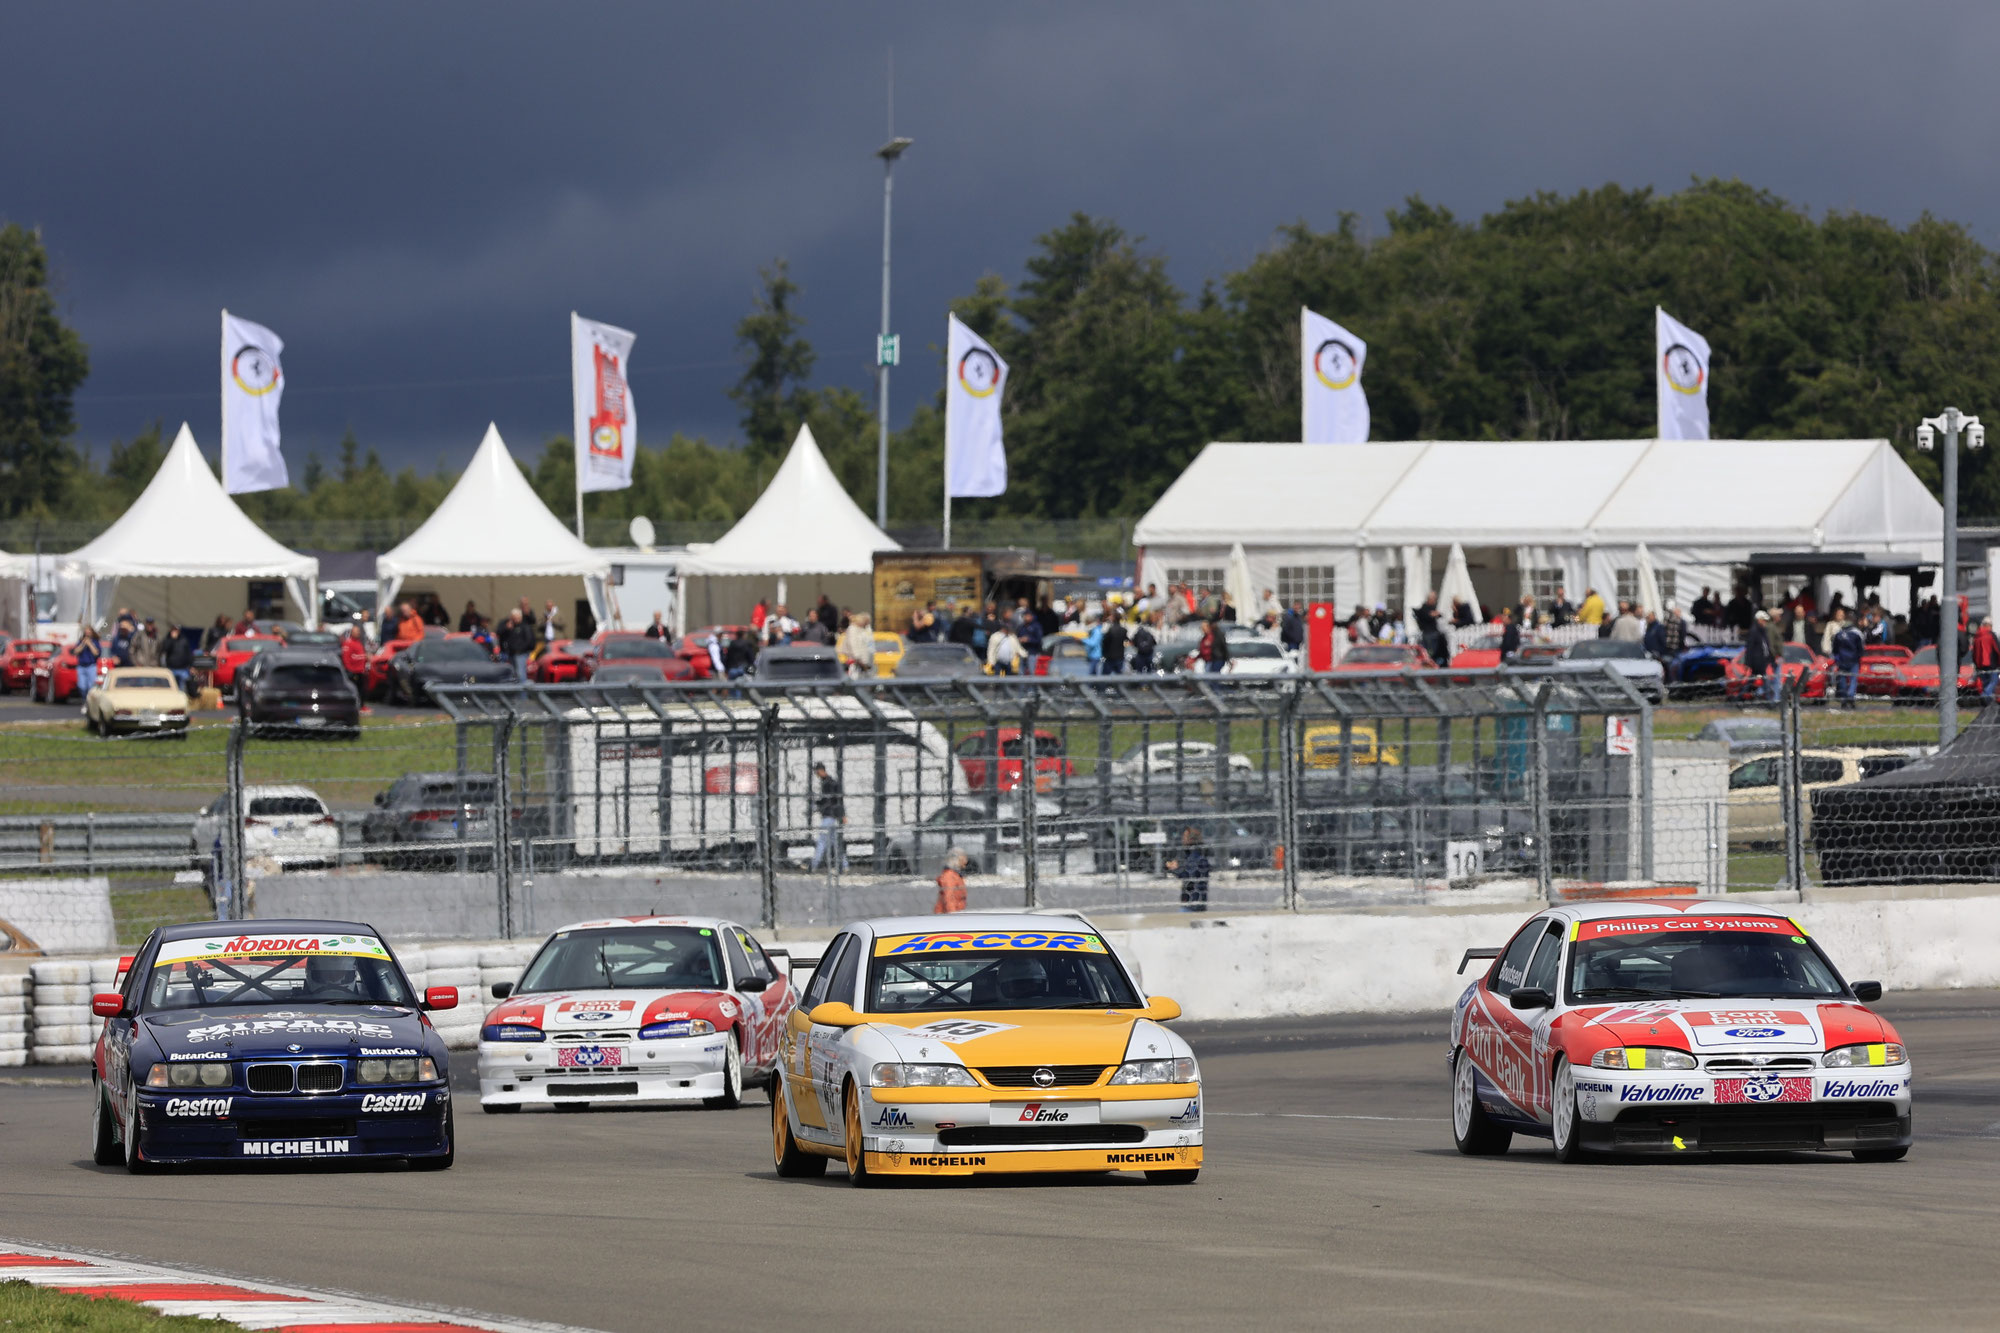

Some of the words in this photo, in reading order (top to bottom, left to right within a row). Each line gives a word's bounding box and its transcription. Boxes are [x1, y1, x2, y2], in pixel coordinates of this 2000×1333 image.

[1453, 851, 1477, 876] 10
[1596, 923, 1660, 933] Philips
[1664, 920, 1699, 930] Car
[1704, 919, 1779, 930] Systems
[223, 936, 320, 953] NORDICA
[888, 933, 1087, 953] ARCOR
[196, 950, 353, 960] www.tourenwagen-golden-era.de
[1498, 960, 1522, 986] Boutsen
[1708, 1010, 1778, 1018] Ford
[1711, 1016, 1785, 1025] Bank
[186, 1020, 392, 1038] MIRAGE
[188, 1028, 274, 1043] GRANITO
[286, 1027, 393, 1039] CERAMICO
[923, 1021, 999, 1036] 45
[1735, 1027, 1775, 1038] Ford
[170, 1051, 228, 1061] ButanGas
[360, 1047, 418, 1056] ButanGas
[1465, 1003, 1493, 1071] Ford
[1495, 1034, 1527, 1106] Bank
[1575, 1082, 1613, 1093] MICHELIN
[1620, 1083, 1704, 1101] Valvoline
[1744, 1083, 1782, 1100] D&W
[1822, 1080, 1899, 1098] Valvoline
[165, 1096, 234, 1118] Castrol
[360, 1092, 427, 1113] Castrol
[1035, 1109, 1069, 1122] Enke
[243, 1140, 349, 1154] MICHELIN
[909, 1157, 986, 1166] MICHELIN
[1107, 1153, 1175, 1163] MICHELIN
